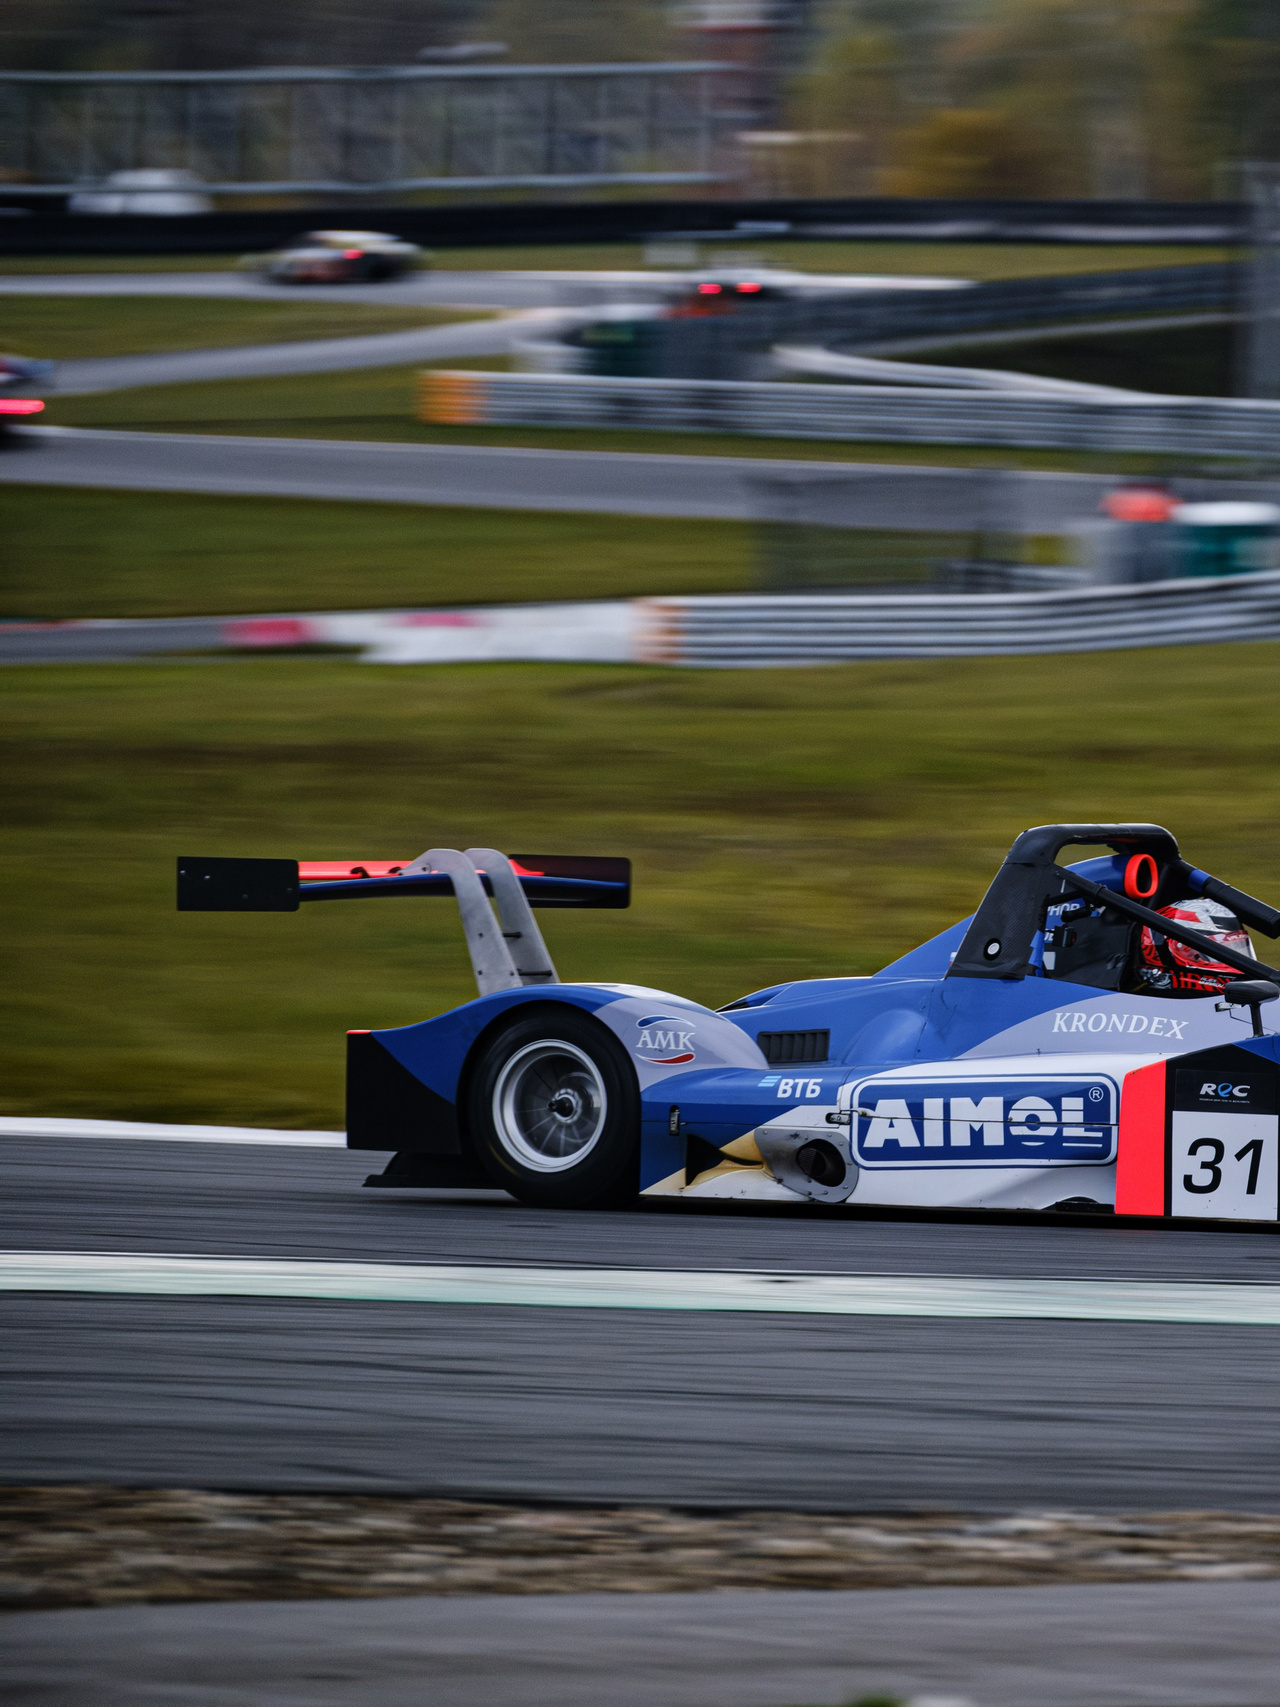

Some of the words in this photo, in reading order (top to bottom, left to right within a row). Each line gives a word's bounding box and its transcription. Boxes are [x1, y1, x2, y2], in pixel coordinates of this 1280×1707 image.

[1052, 1012, 1189, 1040] KRONDEX
[777, 1078, 823, 1098] ВТБ
[1183, 1137, 1264, 1195] 31
